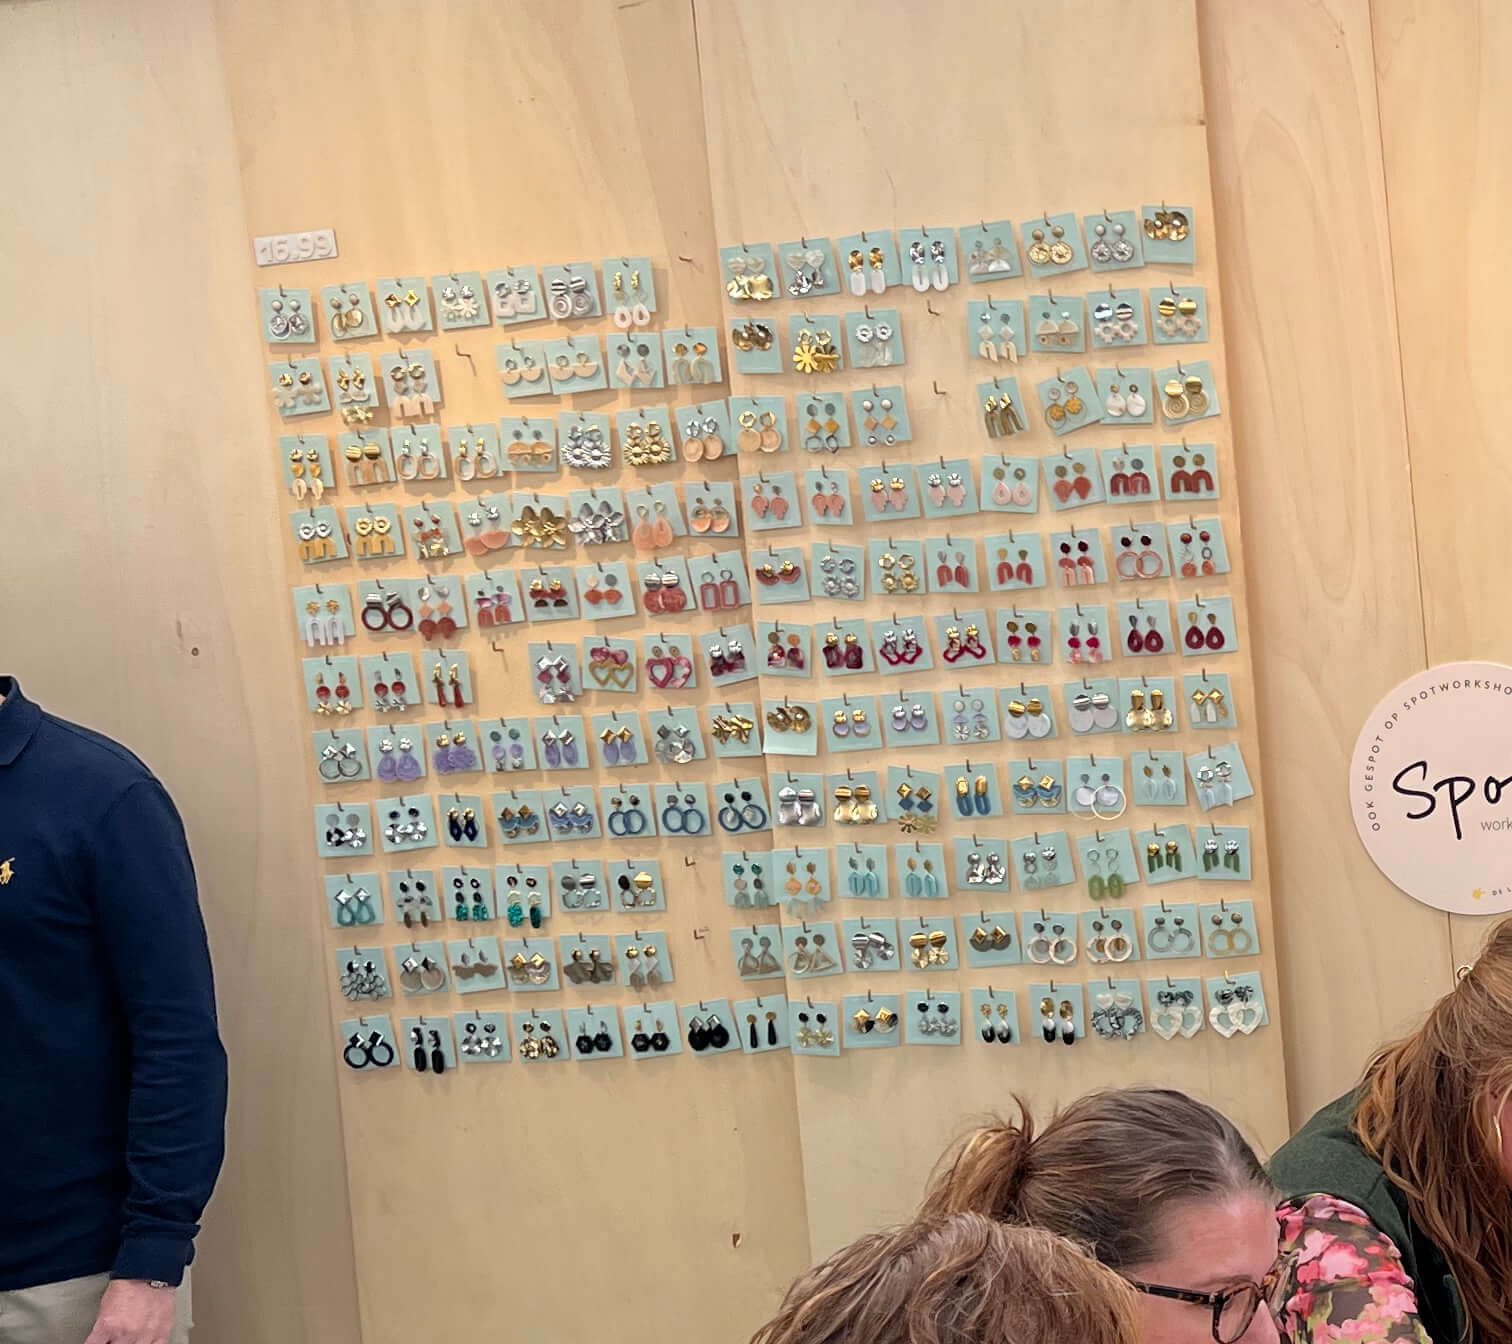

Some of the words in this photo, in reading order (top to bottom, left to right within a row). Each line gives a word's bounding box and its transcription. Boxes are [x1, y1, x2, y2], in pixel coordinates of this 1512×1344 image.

[1384, 712, 1399, 730] OP
[1363, 735, 1385, 792] GESPOT
[1363, 800, 1381, 832] OOK
